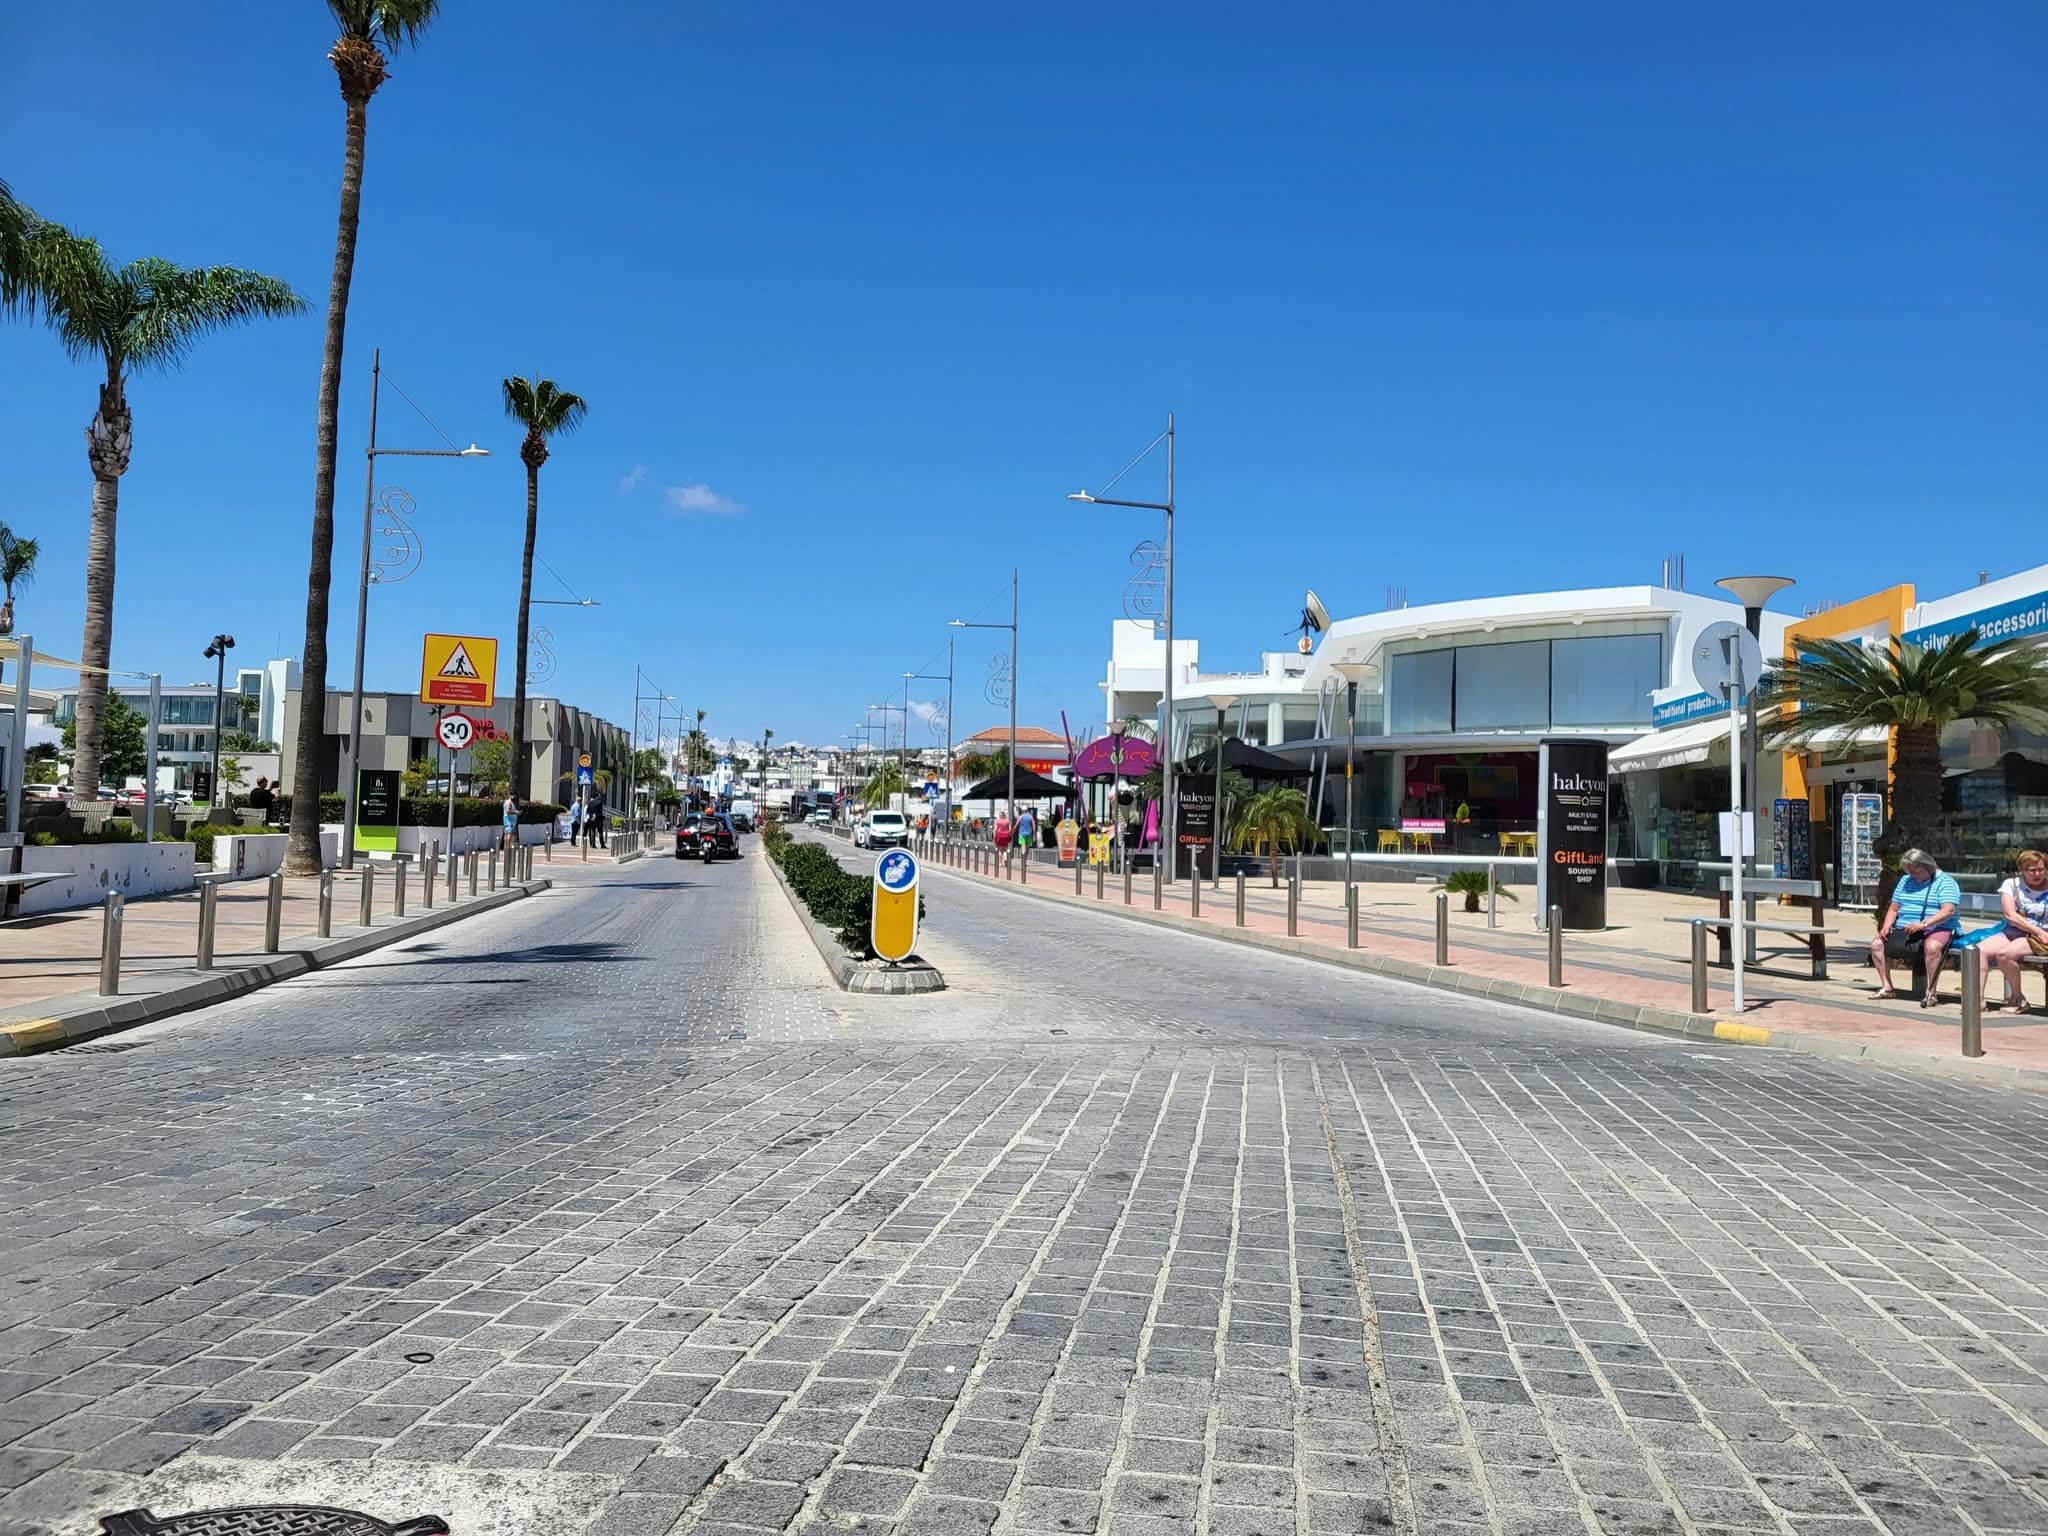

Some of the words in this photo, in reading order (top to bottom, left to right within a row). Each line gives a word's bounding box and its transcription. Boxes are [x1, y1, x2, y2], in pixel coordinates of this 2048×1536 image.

[443, 722, 469, 740] 30
[1552, 772, 1606, 795] halcyon
[1179, 791, 1215, 804] halcyon
[1553, 850, 1604, 865] GiftLand
